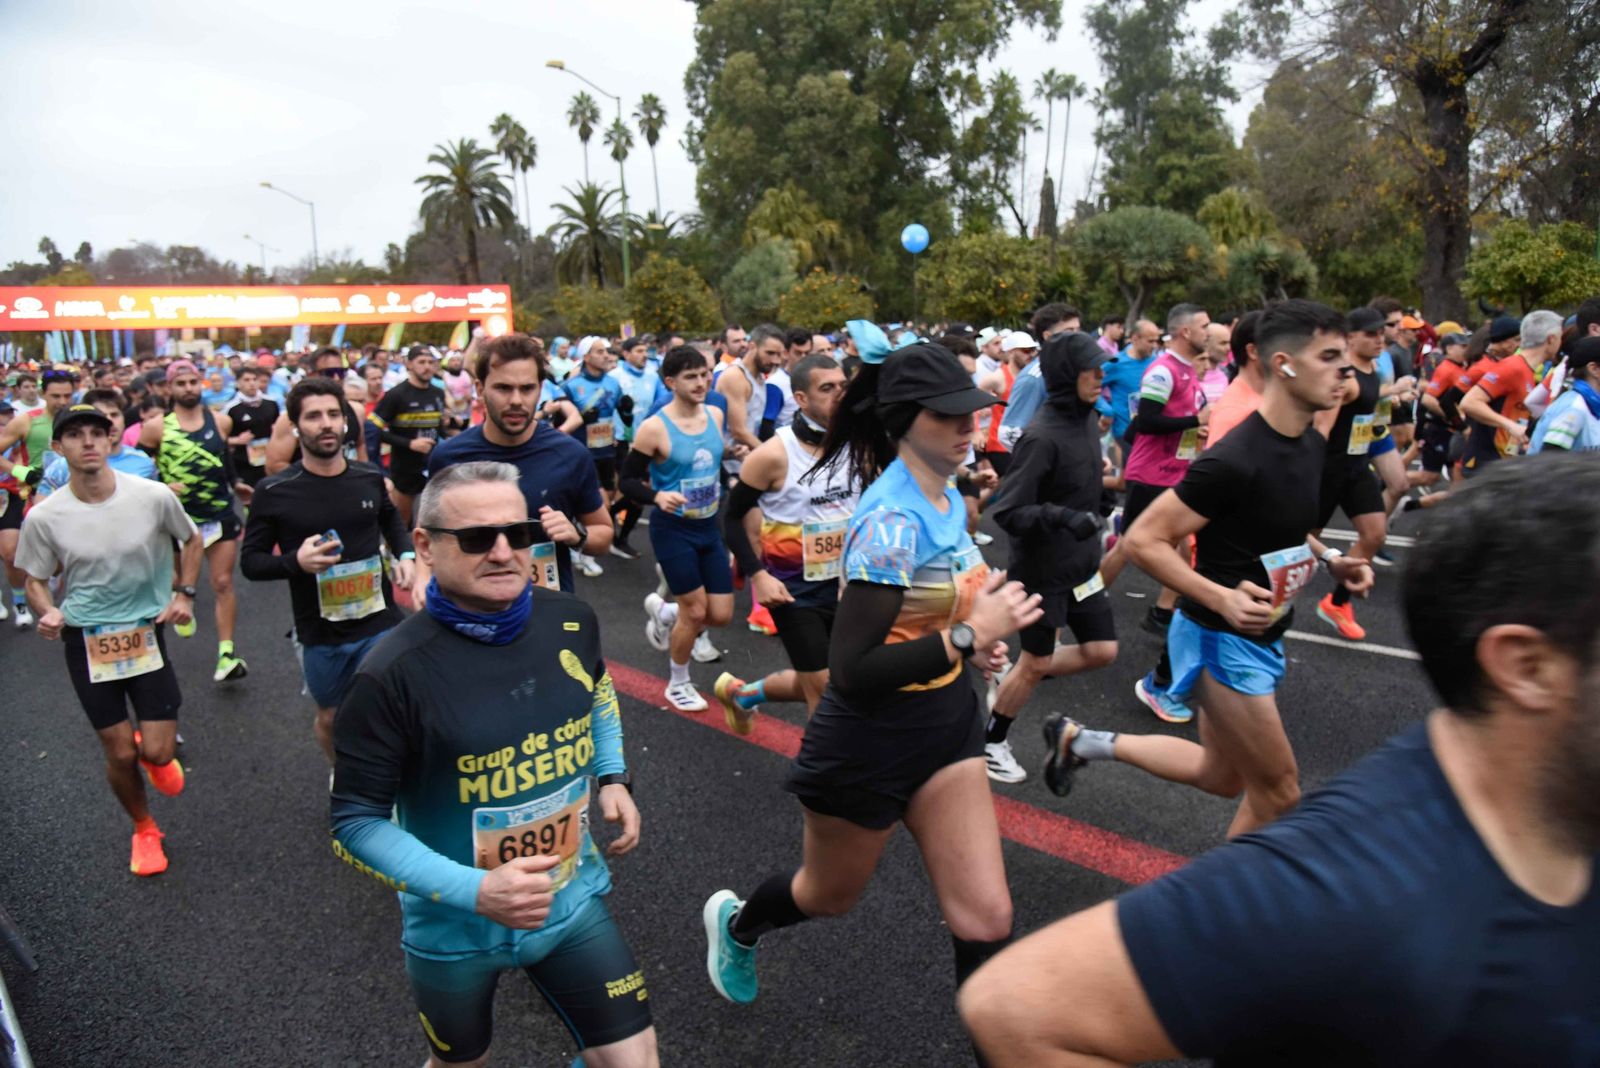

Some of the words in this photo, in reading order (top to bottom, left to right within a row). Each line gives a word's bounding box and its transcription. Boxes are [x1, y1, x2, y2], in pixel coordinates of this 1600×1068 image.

[815, 533, 845, 554] 584
[99, 632, 141, 655] 5330
[457, 746, 516, 773] Grup
[521, 733, 549, 755] de
[499, 814, 572, 864] 6897
